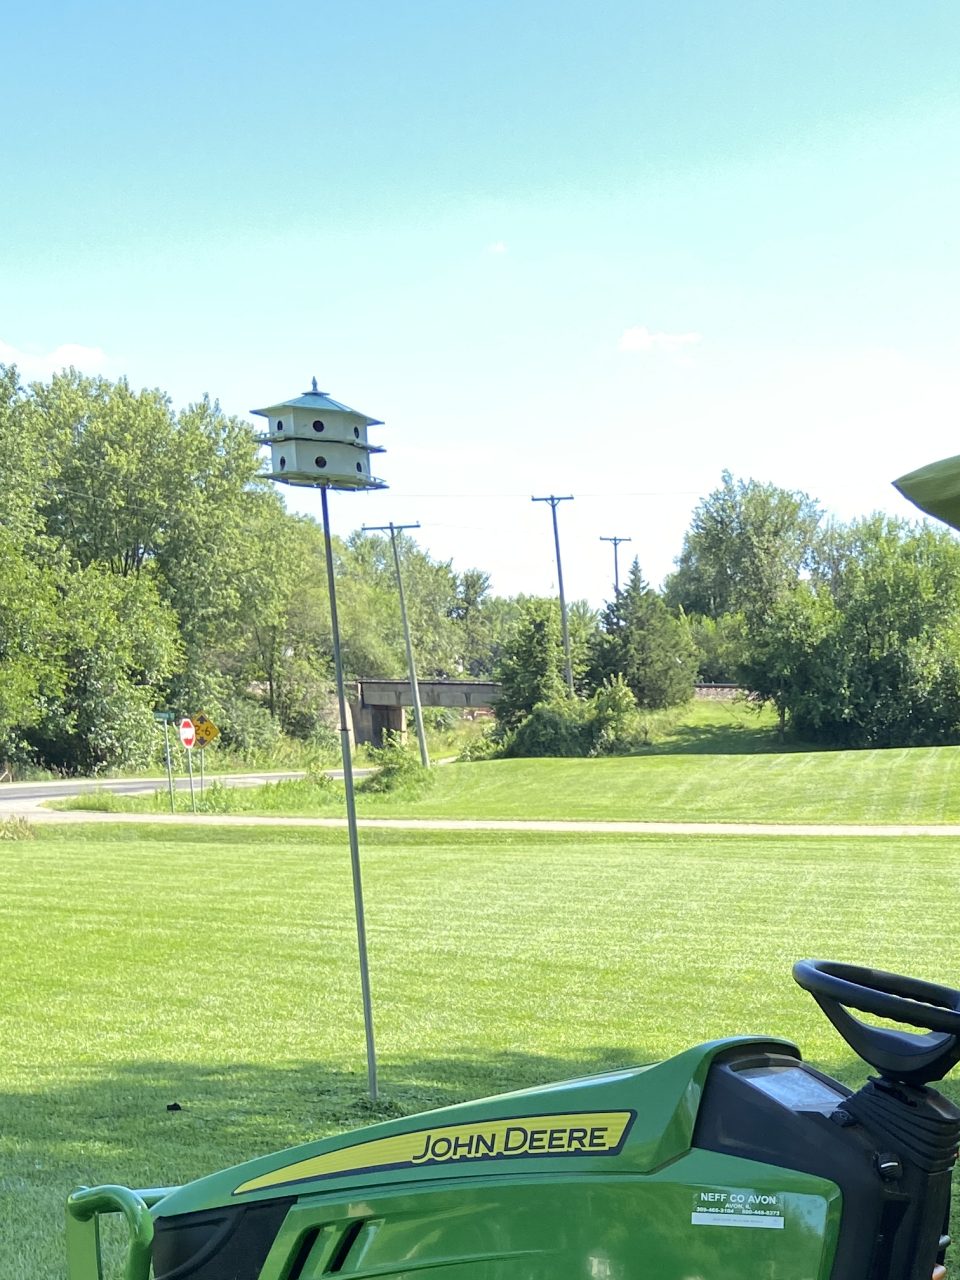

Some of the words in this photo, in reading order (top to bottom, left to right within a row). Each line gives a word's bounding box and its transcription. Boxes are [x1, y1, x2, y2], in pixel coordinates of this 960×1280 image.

[411, 1132, 496, 1162] JOHN
[503, 1125, 609, 1153] DEERE
[700, 1192, 728, 1202] NEFF
[729, 1194, 745, 1203] CO
[747, 1195, 777, 1205] AVON
